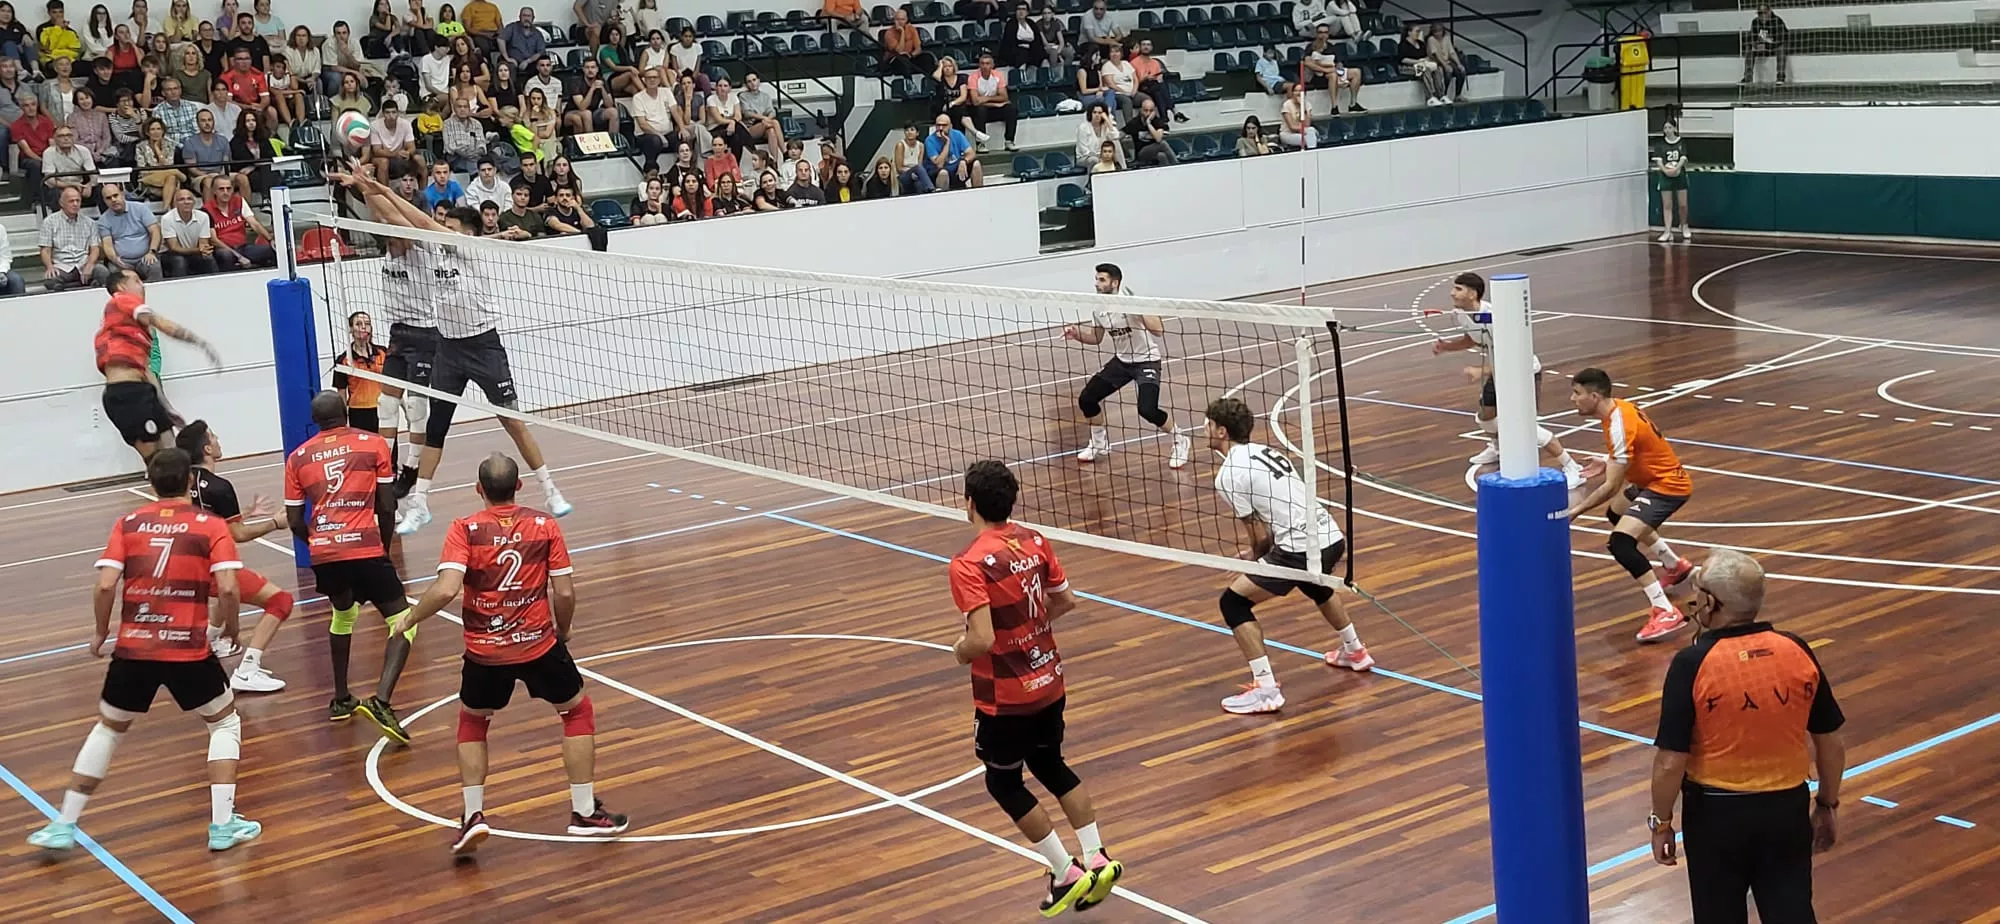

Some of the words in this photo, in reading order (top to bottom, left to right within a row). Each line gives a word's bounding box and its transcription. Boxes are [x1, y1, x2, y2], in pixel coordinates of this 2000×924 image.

[311, 444, 353, 463] ISMAEL
[1250, 447, 1293, 480] 16
[324, 459, 346, 494] 5
[137, 522, 189, 535] ALONSO
[493, 532, 522, 547] FALO
[149, 537, 175, 578] 7
[496, 549, 523, 592] 2
[1021, 572, 1043, 619] 11
